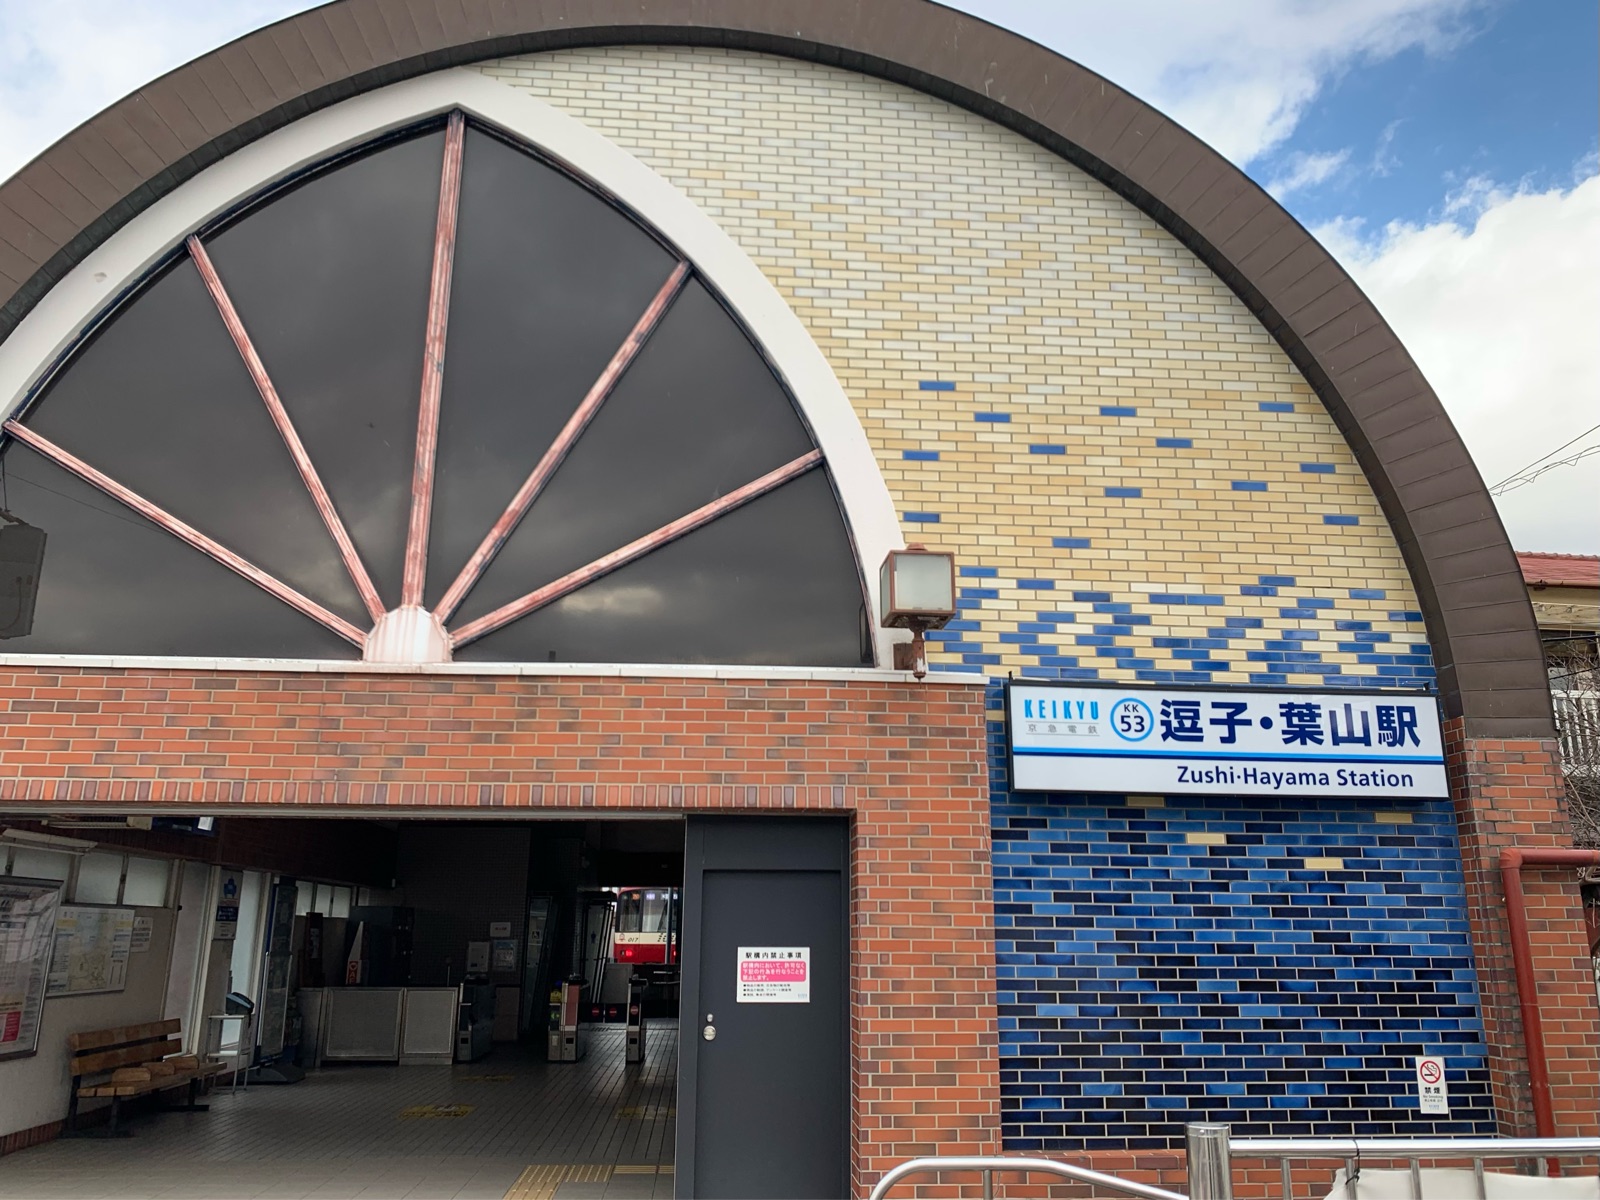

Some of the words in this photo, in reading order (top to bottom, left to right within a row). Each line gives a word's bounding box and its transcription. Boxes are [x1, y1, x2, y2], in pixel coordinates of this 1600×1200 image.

[1024, 699, 1099, 720] KEIKYU
[1123, 703, 1139, 713] KK
[1027, 723, 1098, 735] 京急電鉄
[1120, 715, 1145, 733] 53
[1160, 699, 1421, 748] 逗子・葉山駅
[1336, 769, 1414, 788] Station
[1424, 1086, 1441, 1094] 禁煙
